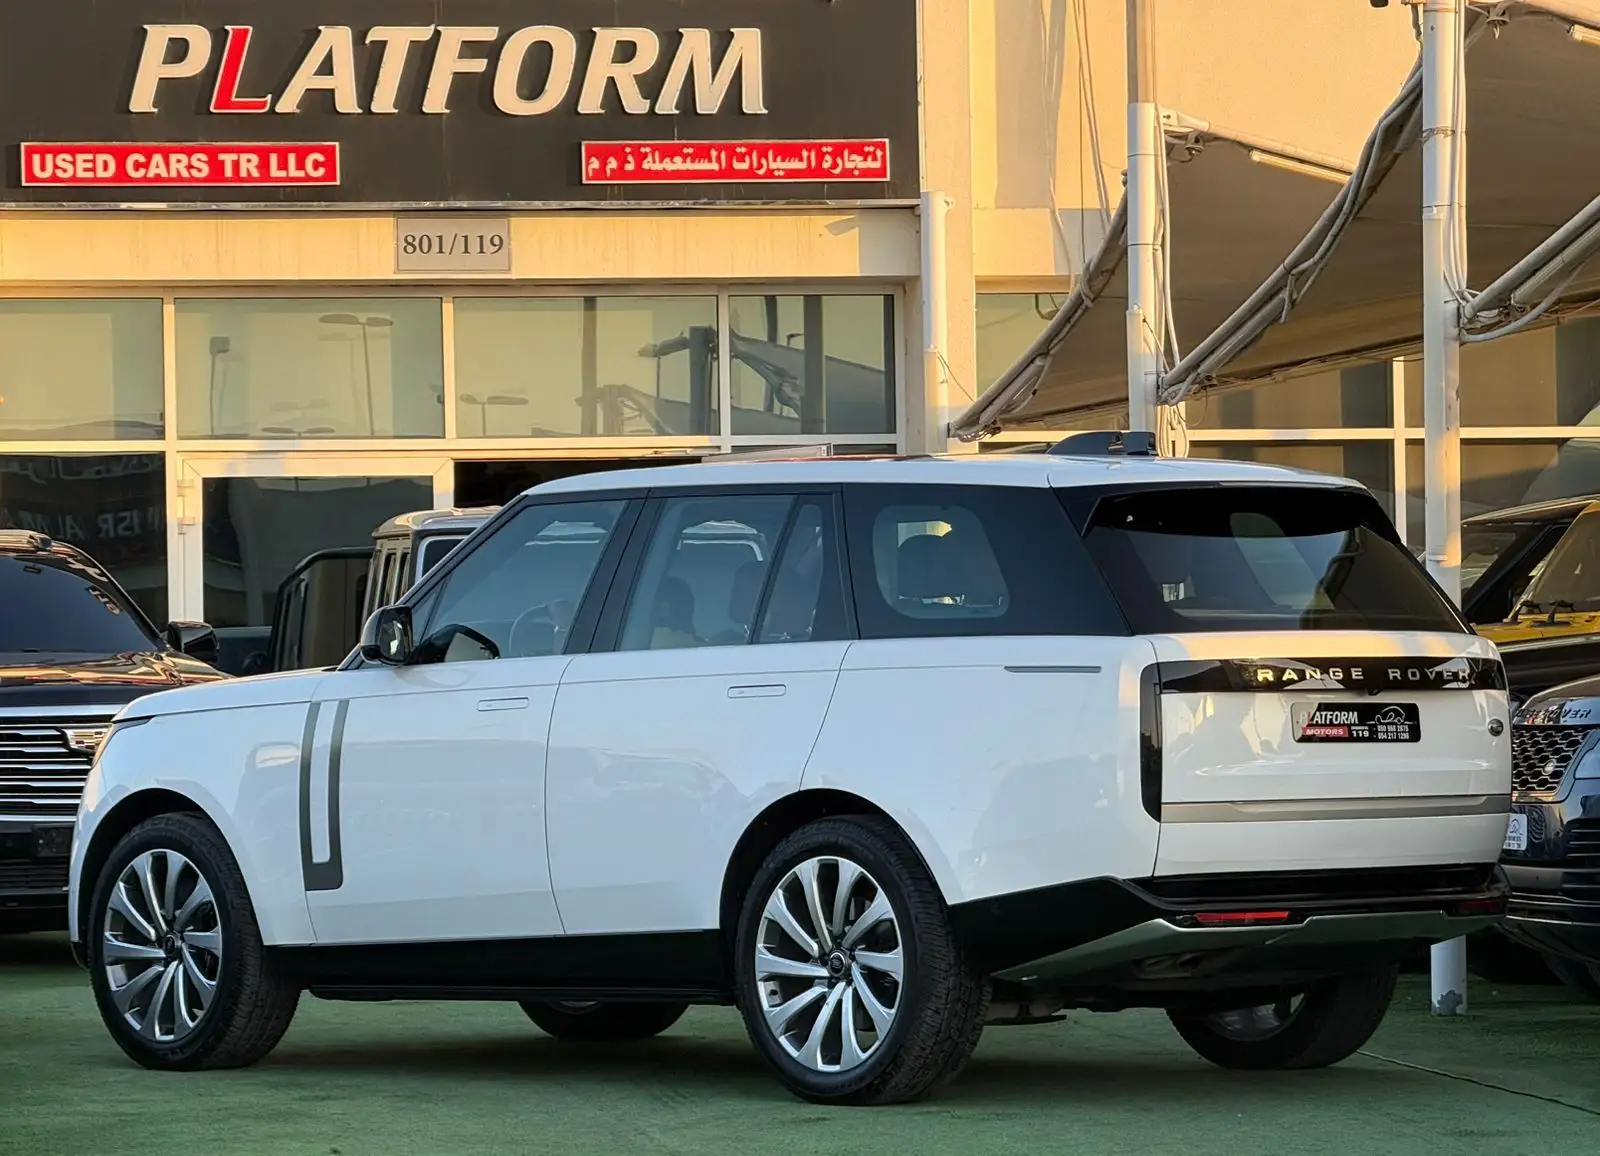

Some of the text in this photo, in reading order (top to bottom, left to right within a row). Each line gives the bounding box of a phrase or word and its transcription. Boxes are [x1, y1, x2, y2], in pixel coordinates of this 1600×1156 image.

[129, 25, 768, 115] PLATFORM
[32, 153, 326, 179] USED CARS TR LLC
[587, 145, 884, 178] لتجارة السيارات المستعملة ذ م م
[402, 233, 504, 255] 801/119
[1256, 667, 1470, 682] RANGE ROVER
[1305, 728, 1344, 736] MOTORS
[1352, 730, 1370, 738] 119
